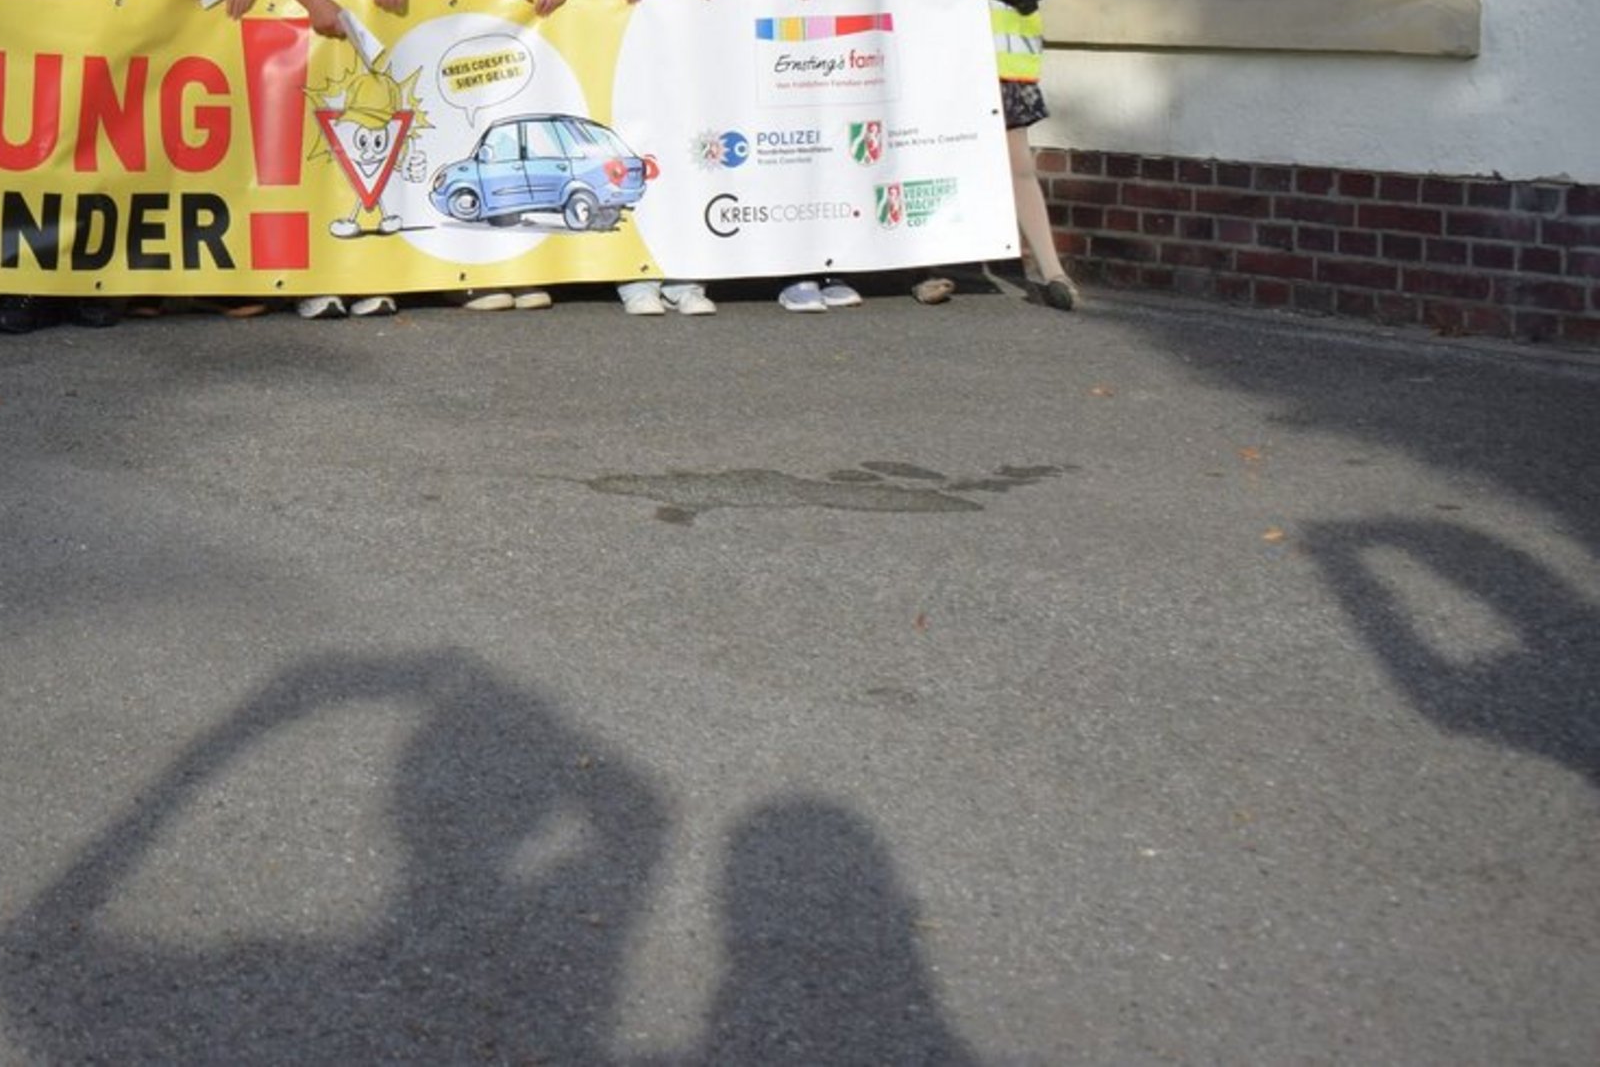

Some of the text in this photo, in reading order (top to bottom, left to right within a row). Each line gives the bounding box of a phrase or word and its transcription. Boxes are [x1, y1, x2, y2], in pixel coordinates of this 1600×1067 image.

[442, 51, 526, 77] KREIS COESFELD
[756, 129, 821, 146] POLIZEI
